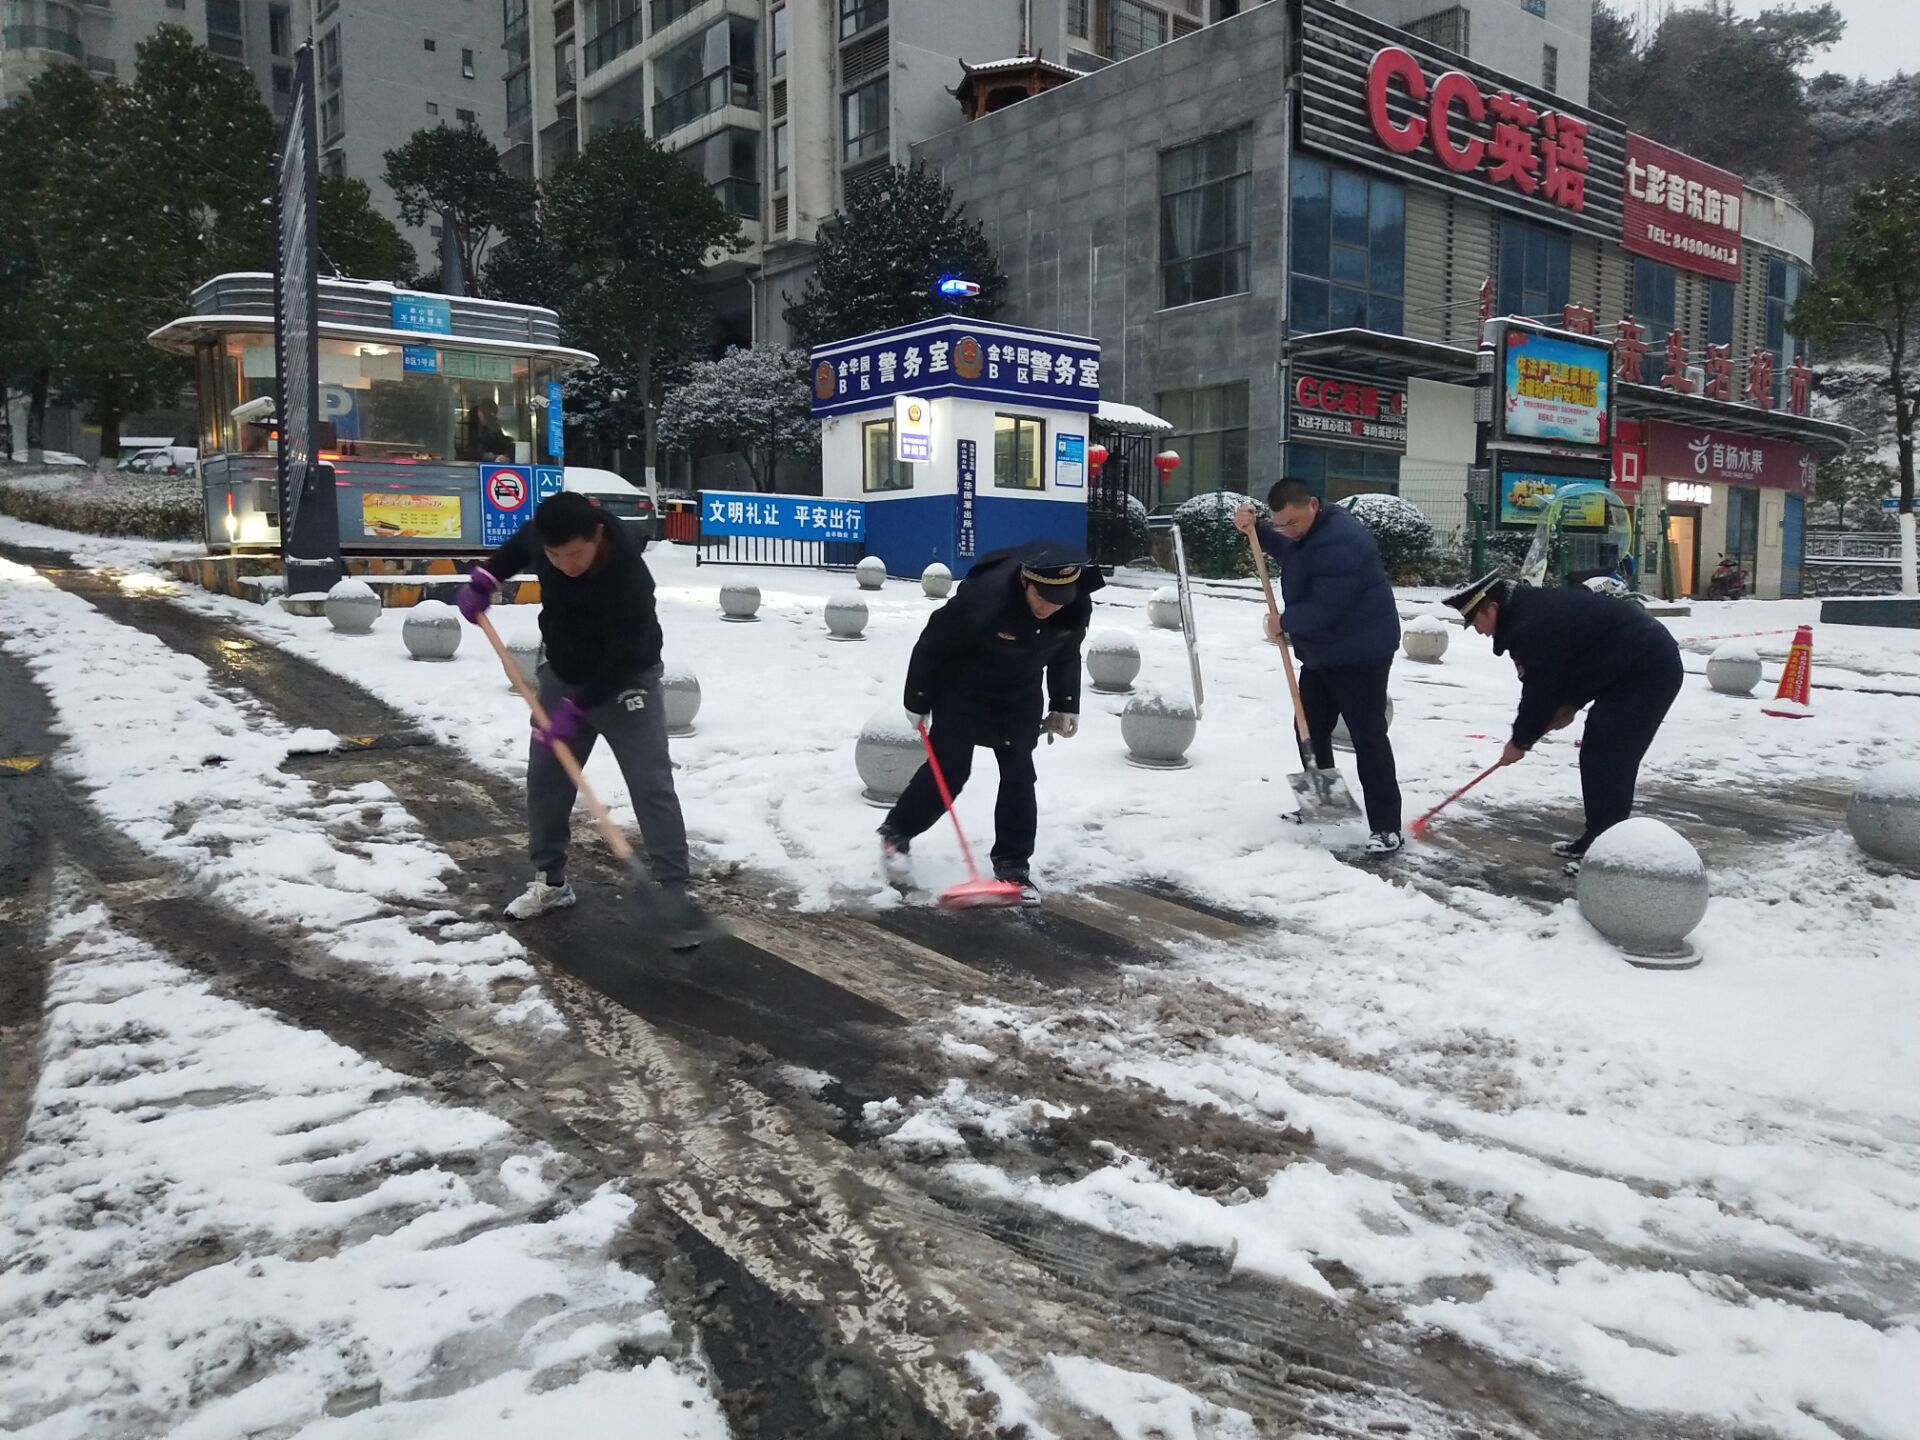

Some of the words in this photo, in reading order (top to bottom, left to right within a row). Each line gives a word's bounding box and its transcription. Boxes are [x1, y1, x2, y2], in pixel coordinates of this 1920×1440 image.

[1365, 46, 1589, 212] CC英语
[1626, 157, 1740, 231] 七彩音乐培训
[838, 355, 870, 377] 金华园
[878, 340, 950, 384] 警务室
[987, 343, 1030, 365] 金华园
[1030, 349, 1100, 389] 警务室
[541, 473, 562, 487] 入口
[1713, 443, 1764, 473] 首杨水果
[709, 500, 780, 526] 文明礼让
[794, 505, 863, 530] 平安出行
